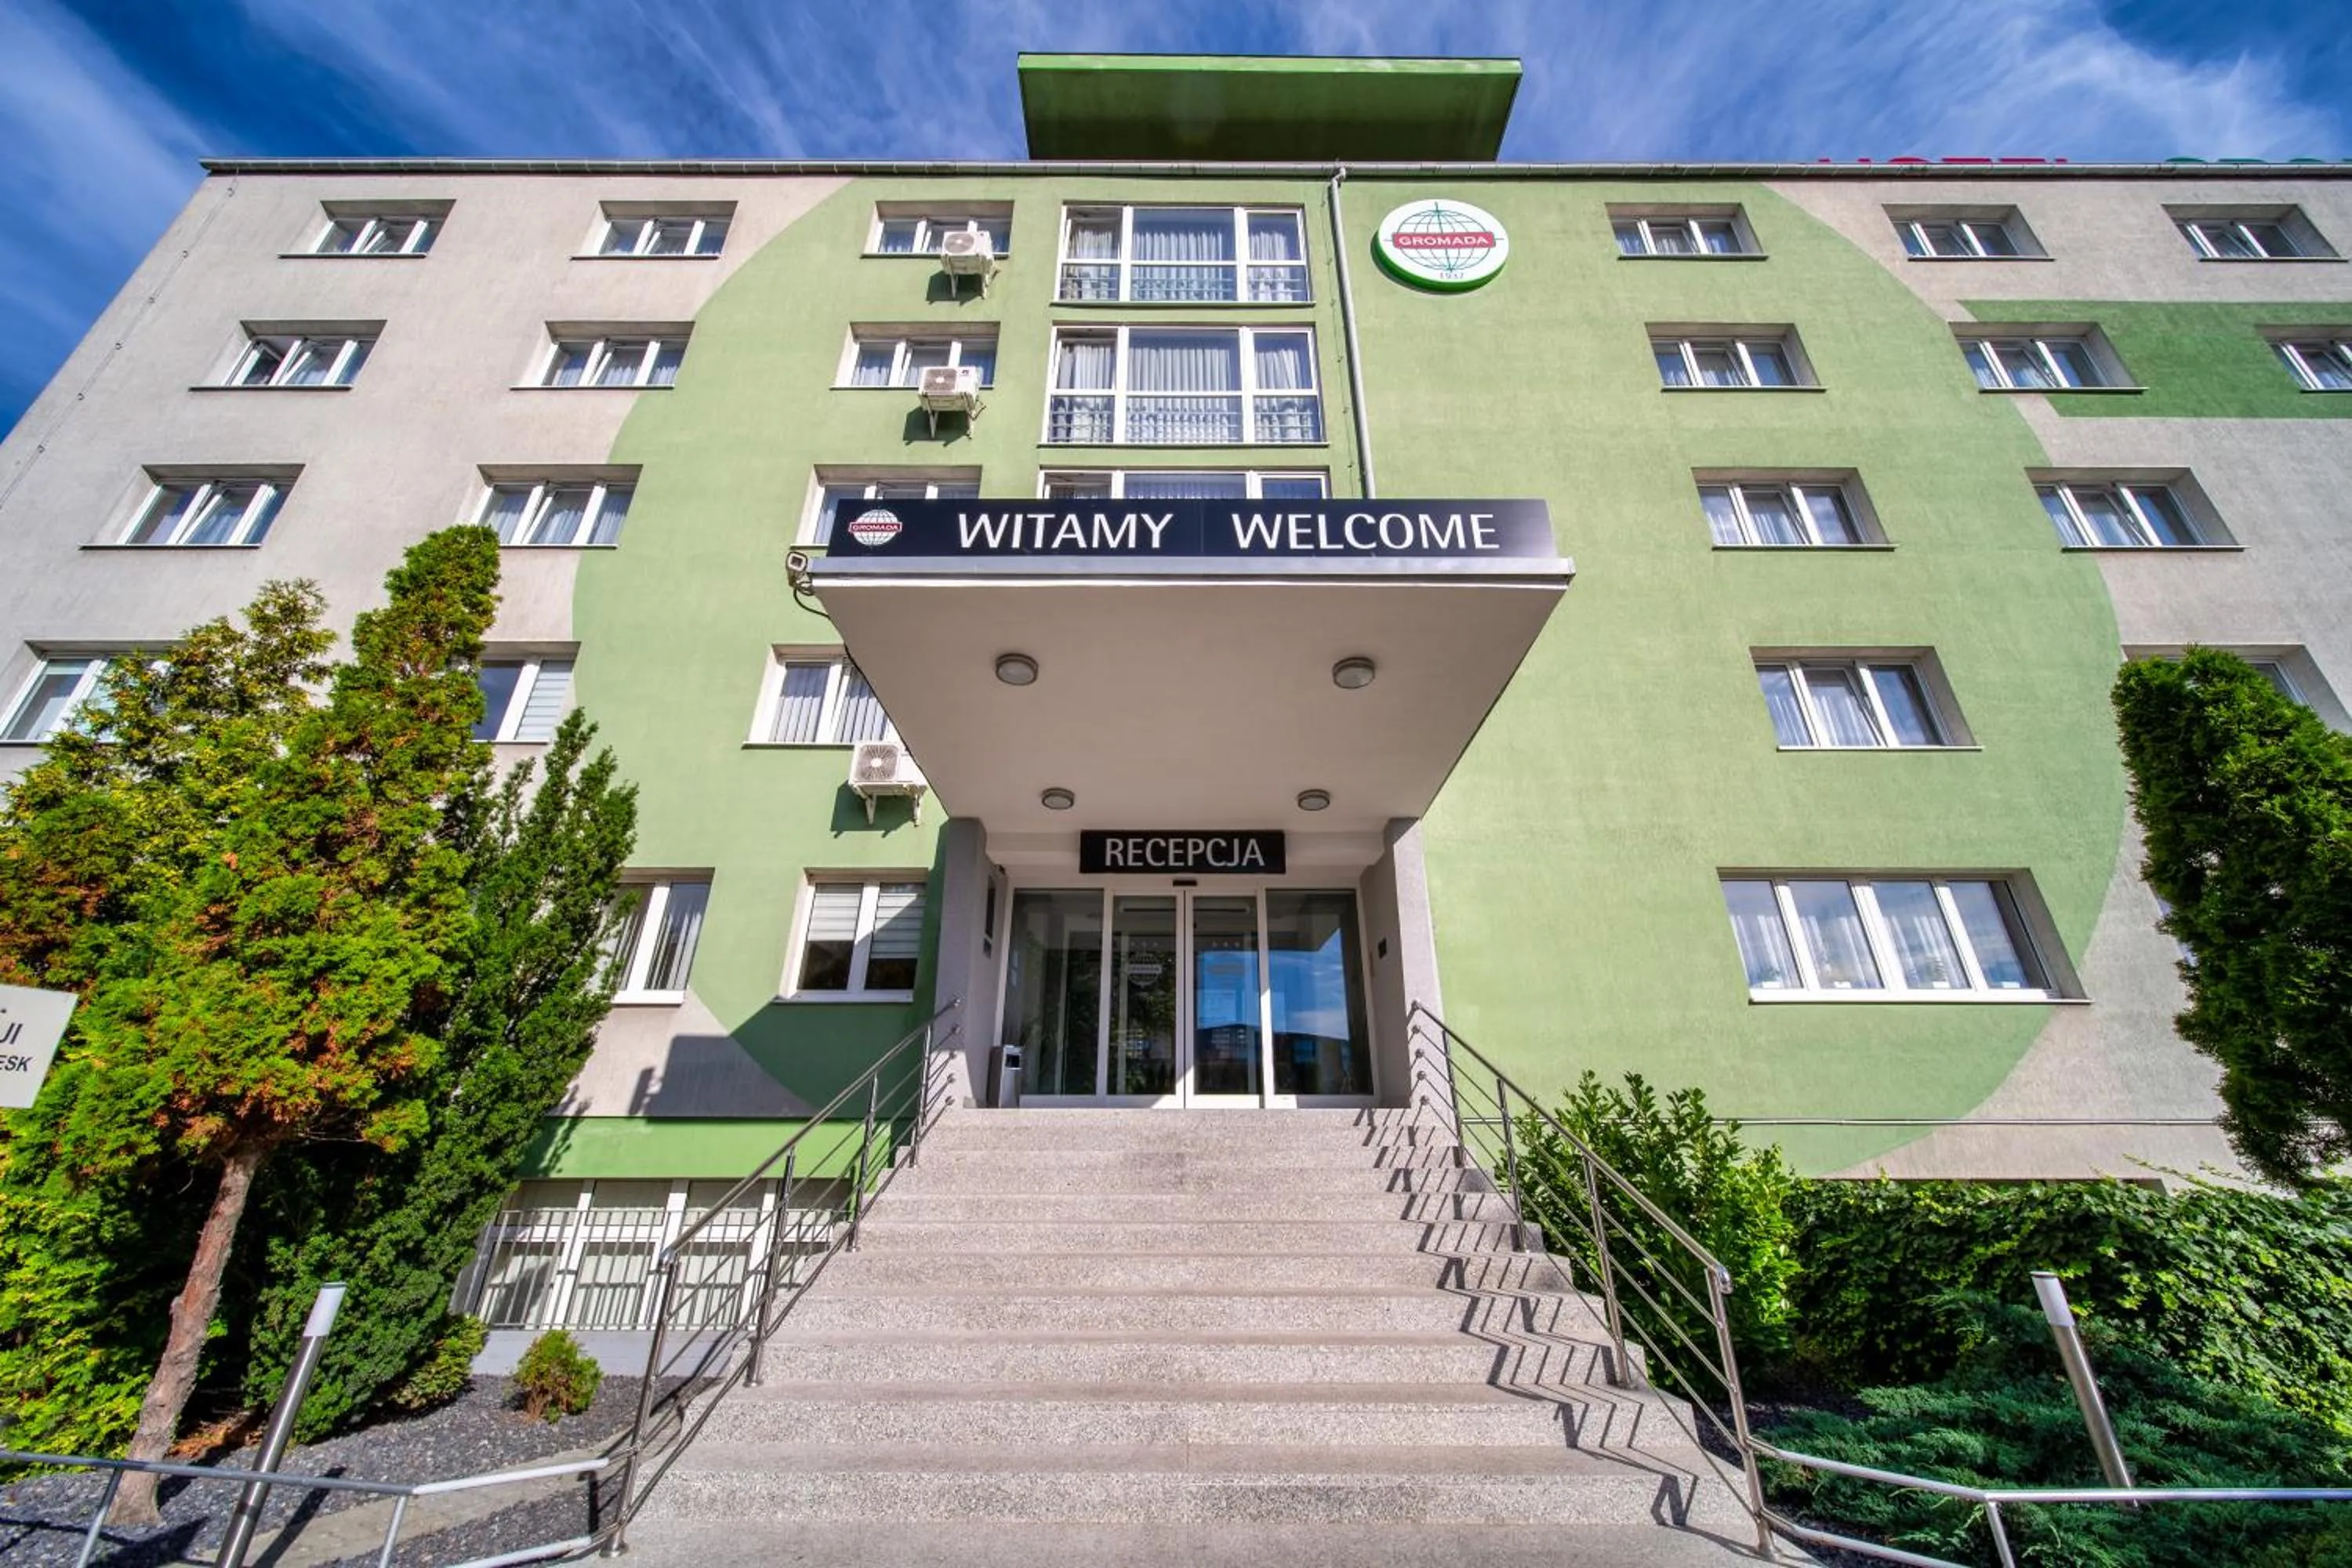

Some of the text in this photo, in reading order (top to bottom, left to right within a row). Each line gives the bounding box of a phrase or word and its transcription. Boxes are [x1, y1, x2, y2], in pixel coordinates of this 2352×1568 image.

[1398, 236, 1489, 245] GROMADA
[958, 514, 1500, 550] WITAMY WELCOME
[1105, 838, 1265, 867] RECEPCJA
